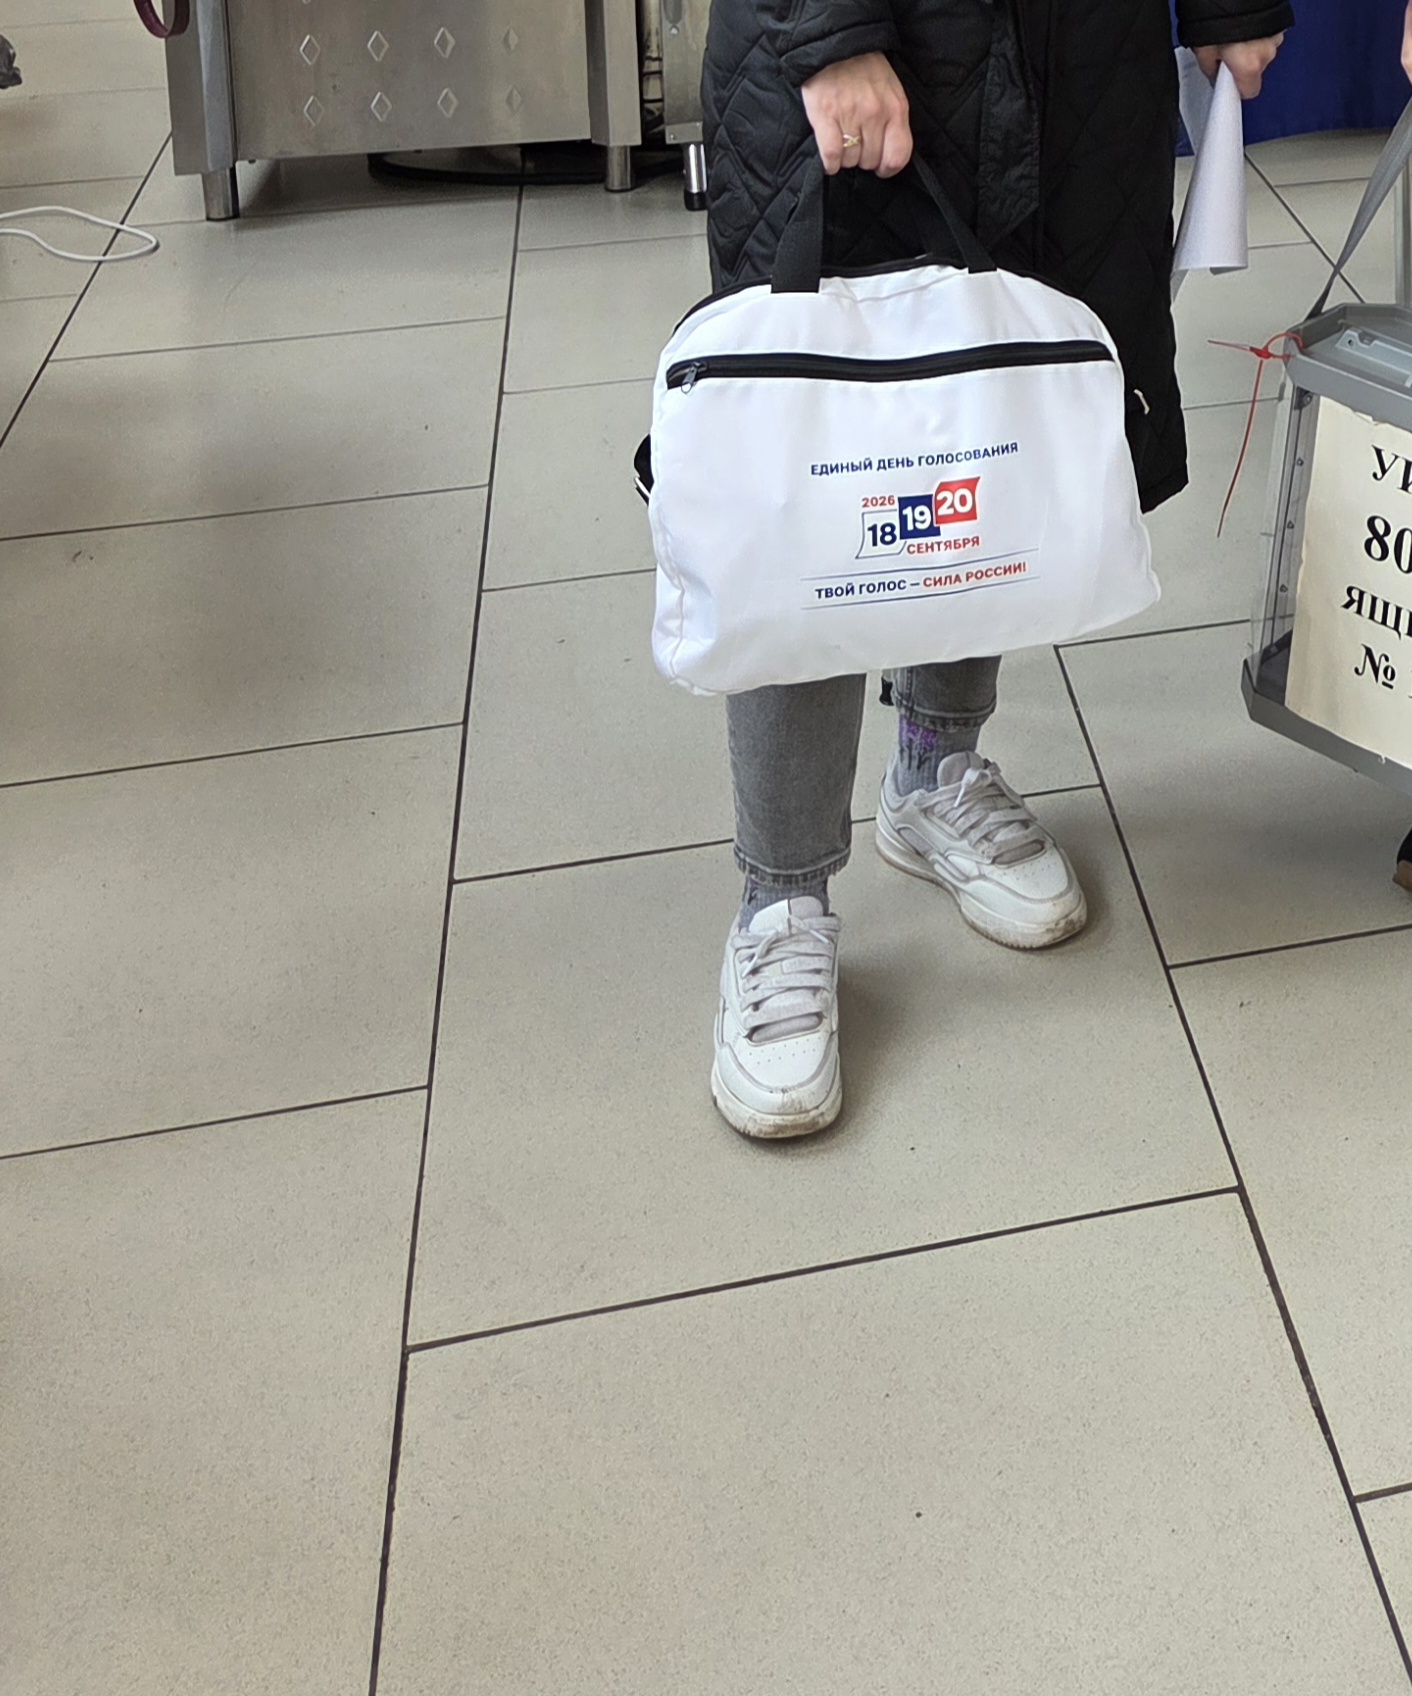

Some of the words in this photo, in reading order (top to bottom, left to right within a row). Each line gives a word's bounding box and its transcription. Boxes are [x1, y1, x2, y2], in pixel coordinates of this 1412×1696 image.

[811, 458, 873, 476] ЕДИНЫЙ
[876, 453, 915, 472] ДЕНЬ
[918, 442, 1018, 466] ГОЛОСОВАНИЯ
[861, 496, 896, 508] 2026
[937, 488, 973, 516] 20
[903, 505, 931, 531] 19
[867, 523, 898, 547] 18
[906, 536, 981, 555] СЕНТЯБРЯ
[815, 582, 856, 599] ТВОЙ
[858, 578, 908, 594] ГОЛОС
[923, 572, 963, 589] СИЛА
[966, 561, 1027, 582] РОССИИ!
[1354, 643, 1397, 691] №
